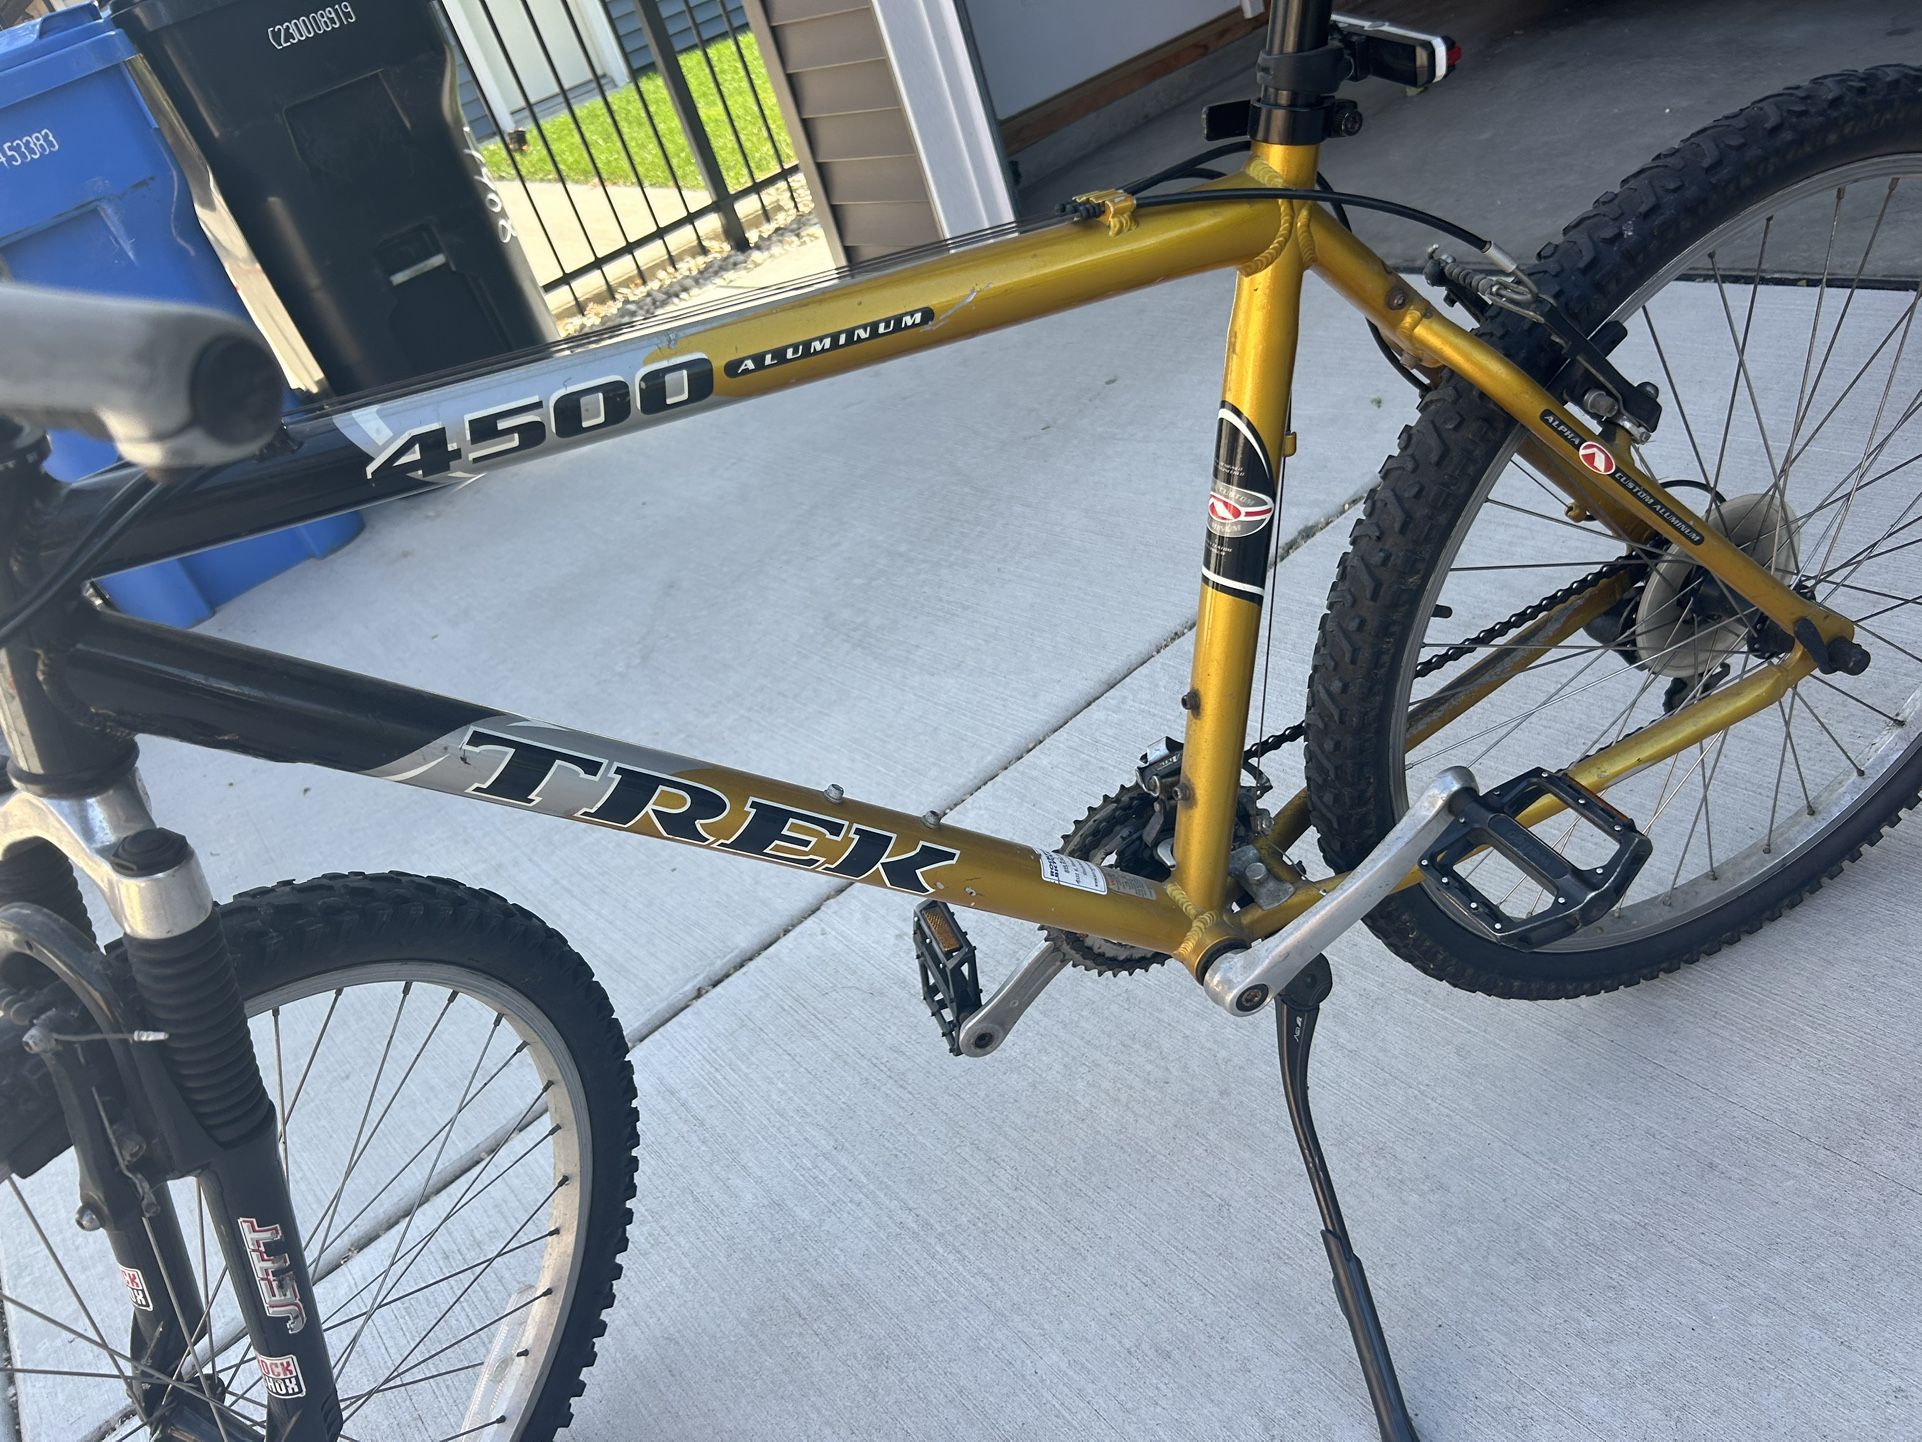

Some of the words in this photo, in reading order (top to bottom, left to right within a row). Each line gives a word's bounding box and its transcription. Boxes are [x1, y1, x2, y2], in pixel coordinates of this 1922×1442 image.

[267, 1, 355, 49] C230008919
[366, 353, 715, 480] 4500
[738, 311, 922, 374] ALUMINUM
[1544, 415, 1580, 445] ALPHA
[1615, 472, 1654, 505] CUSTOM
[1654, 504, 1700, 542] ALUMINUM
[459, 725, 961, 895] TREK
[237, 1217, 306, 1334] JETT
[259, 1359, 294, 1377] OCK
[264, 1376, 299, 1394] HOX
